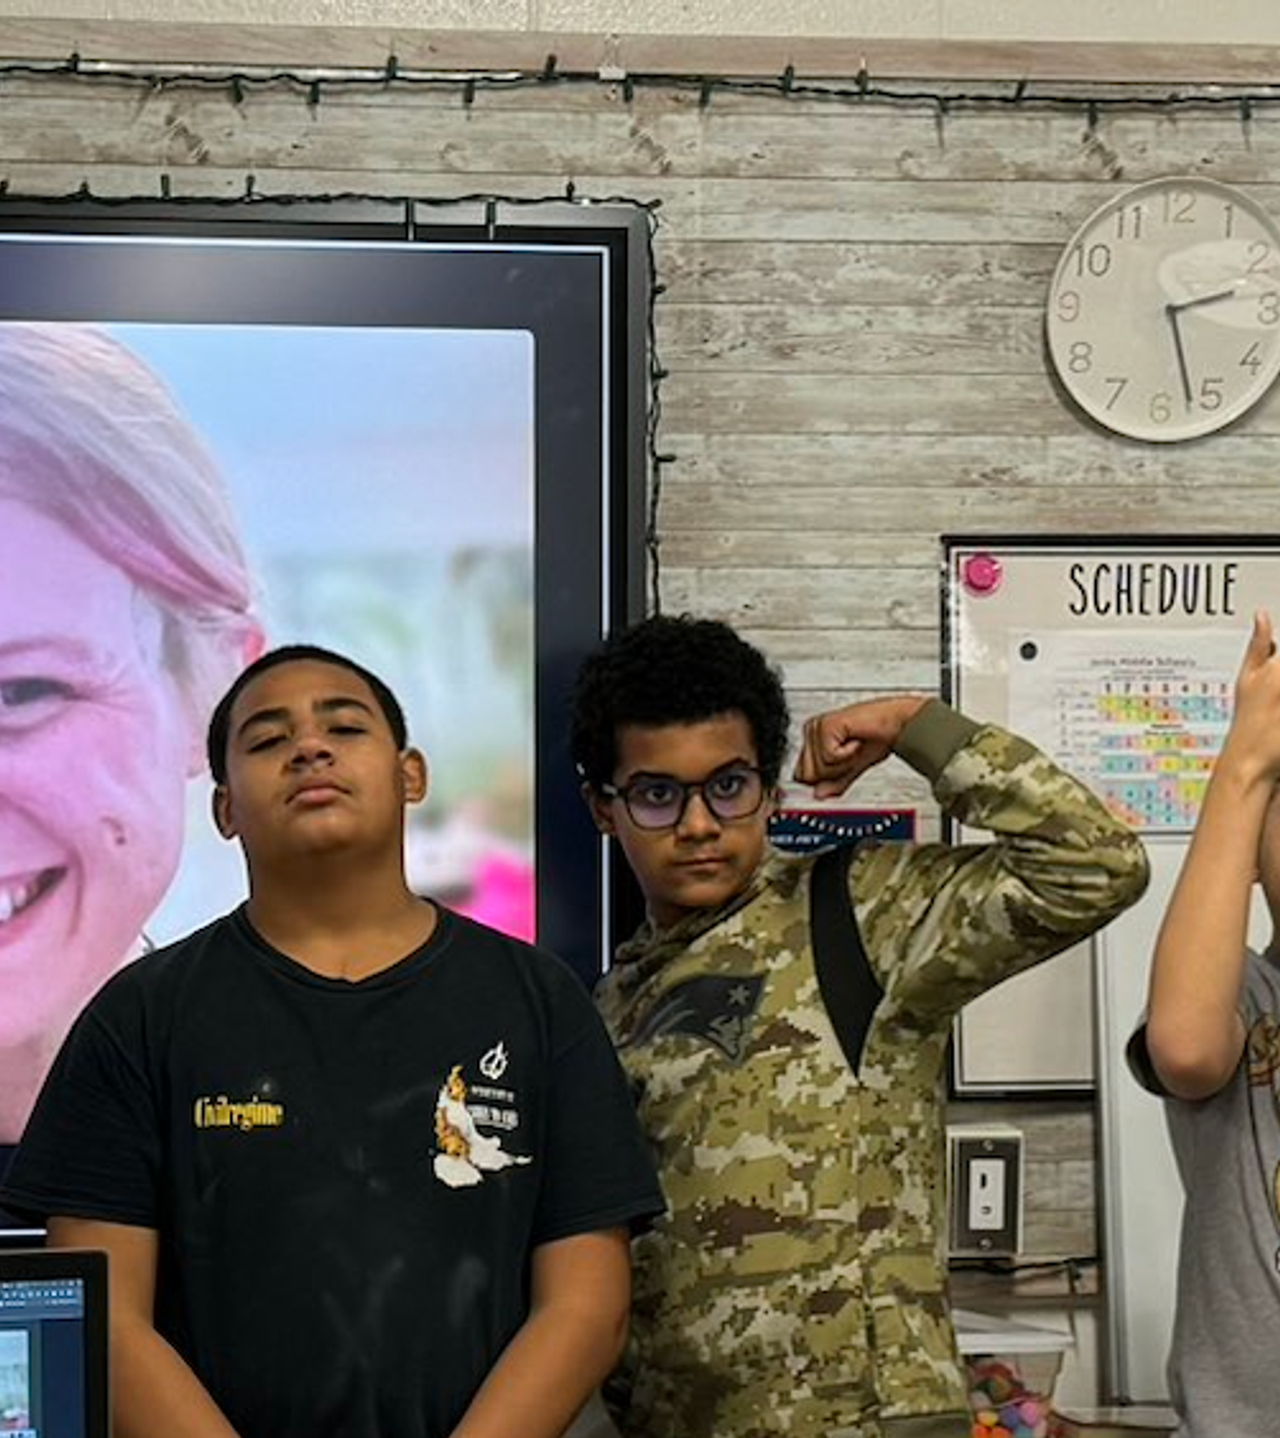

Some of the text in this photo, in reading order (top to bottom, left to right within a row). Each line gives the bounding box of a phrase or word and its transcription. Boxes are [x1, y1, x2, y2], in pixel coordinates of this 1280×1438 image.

[1117, 206, 1141, 239] 11
[1162, 189, 1196, 223] 12
[1223, 204, 1234, 238] 1
[1075, 243, 1111, 277] 10
[1247, 241, 1271, 274] 2
[1057, 291, 1080, 322] 9
[1257, 291, 1280, 324] 3
[1069, 341, 1093, 373] 8
[1239, 342, 1262, 375] 4
[1105, 377, 1129, 411] 7
[1149, 392, 1171, 424] 6
[1199, 378, 1223, 411] 5
[1068, 563, 1238, 616] SCHEDULE
